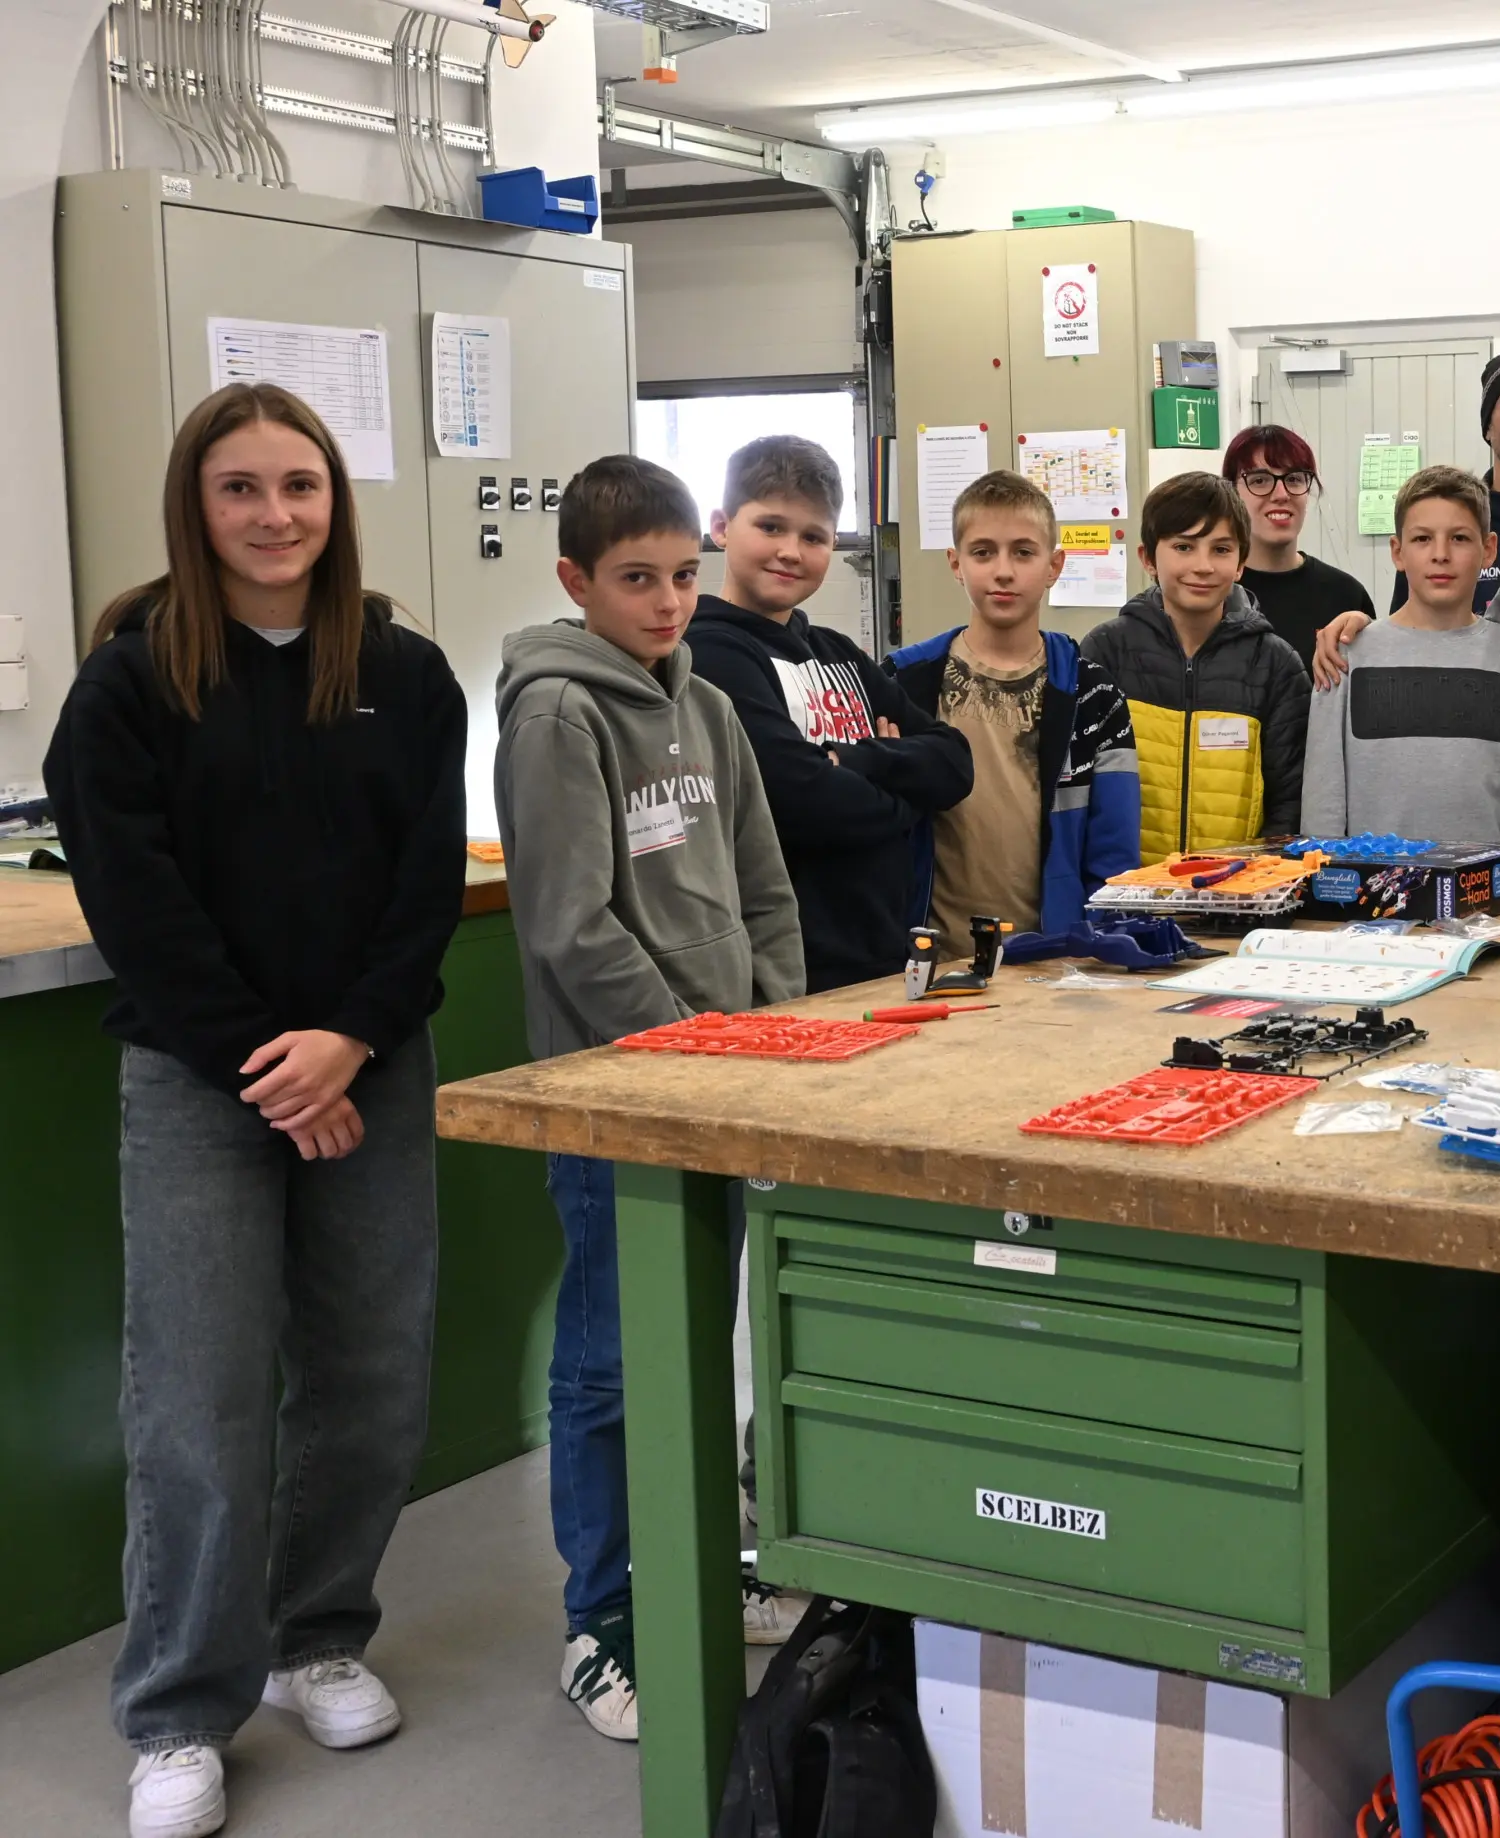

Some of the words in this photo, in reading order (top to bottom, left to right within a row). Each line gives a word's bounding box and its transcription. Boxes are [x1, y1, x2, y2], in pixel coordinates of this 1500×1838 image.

[1443, 877, 1452, 918] KOSMOS
[1459, 870, 1490, 889] Cyborg
[981, 1492, 1101, 1536] SCELBEZ
